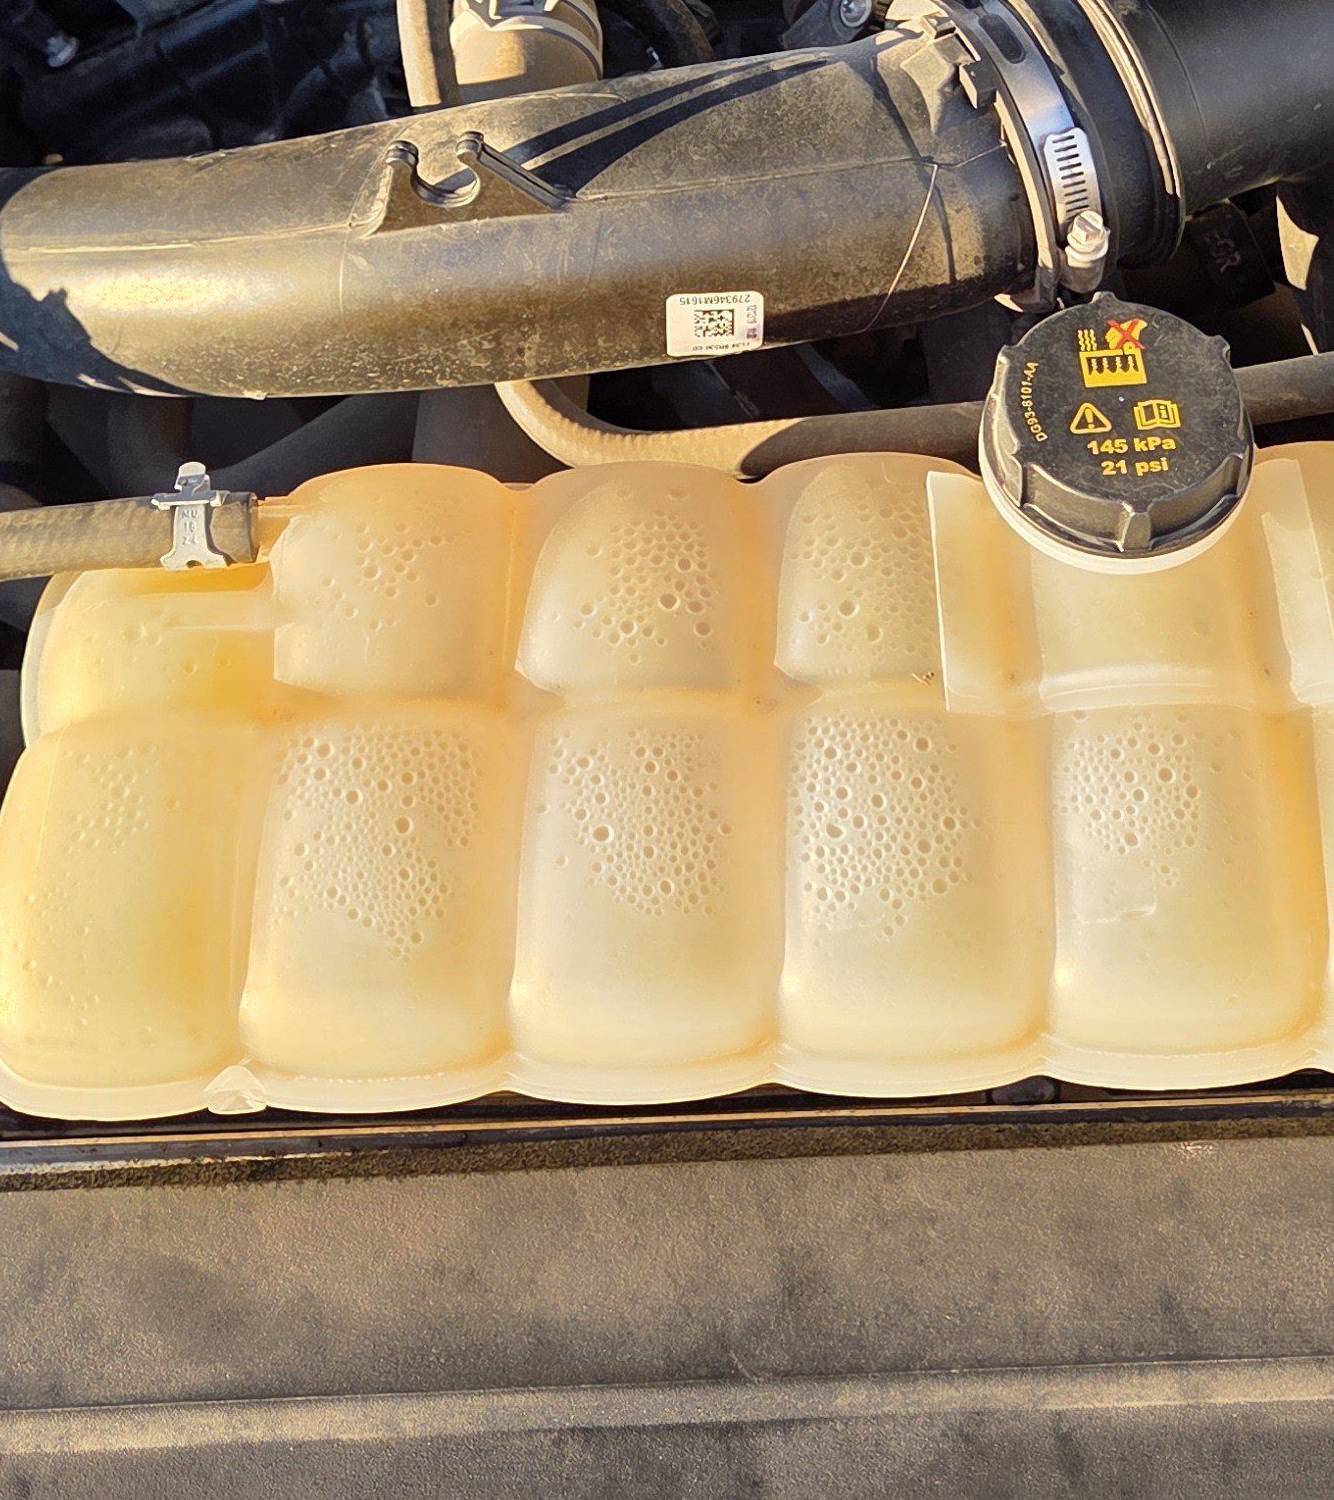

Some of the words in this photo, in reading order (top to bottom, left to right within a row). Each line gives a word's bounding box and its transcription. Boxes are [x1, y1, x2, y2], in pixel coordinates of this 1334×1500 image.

[1020, 362, 1048, 442] DG93-8101-AA
[1087, 439, 1128, 455] 145
[1135, 438, 1177, 453] kPa
[1102, 460, 1127, 474] 21
[1136, 458, 1169, 477] psi
